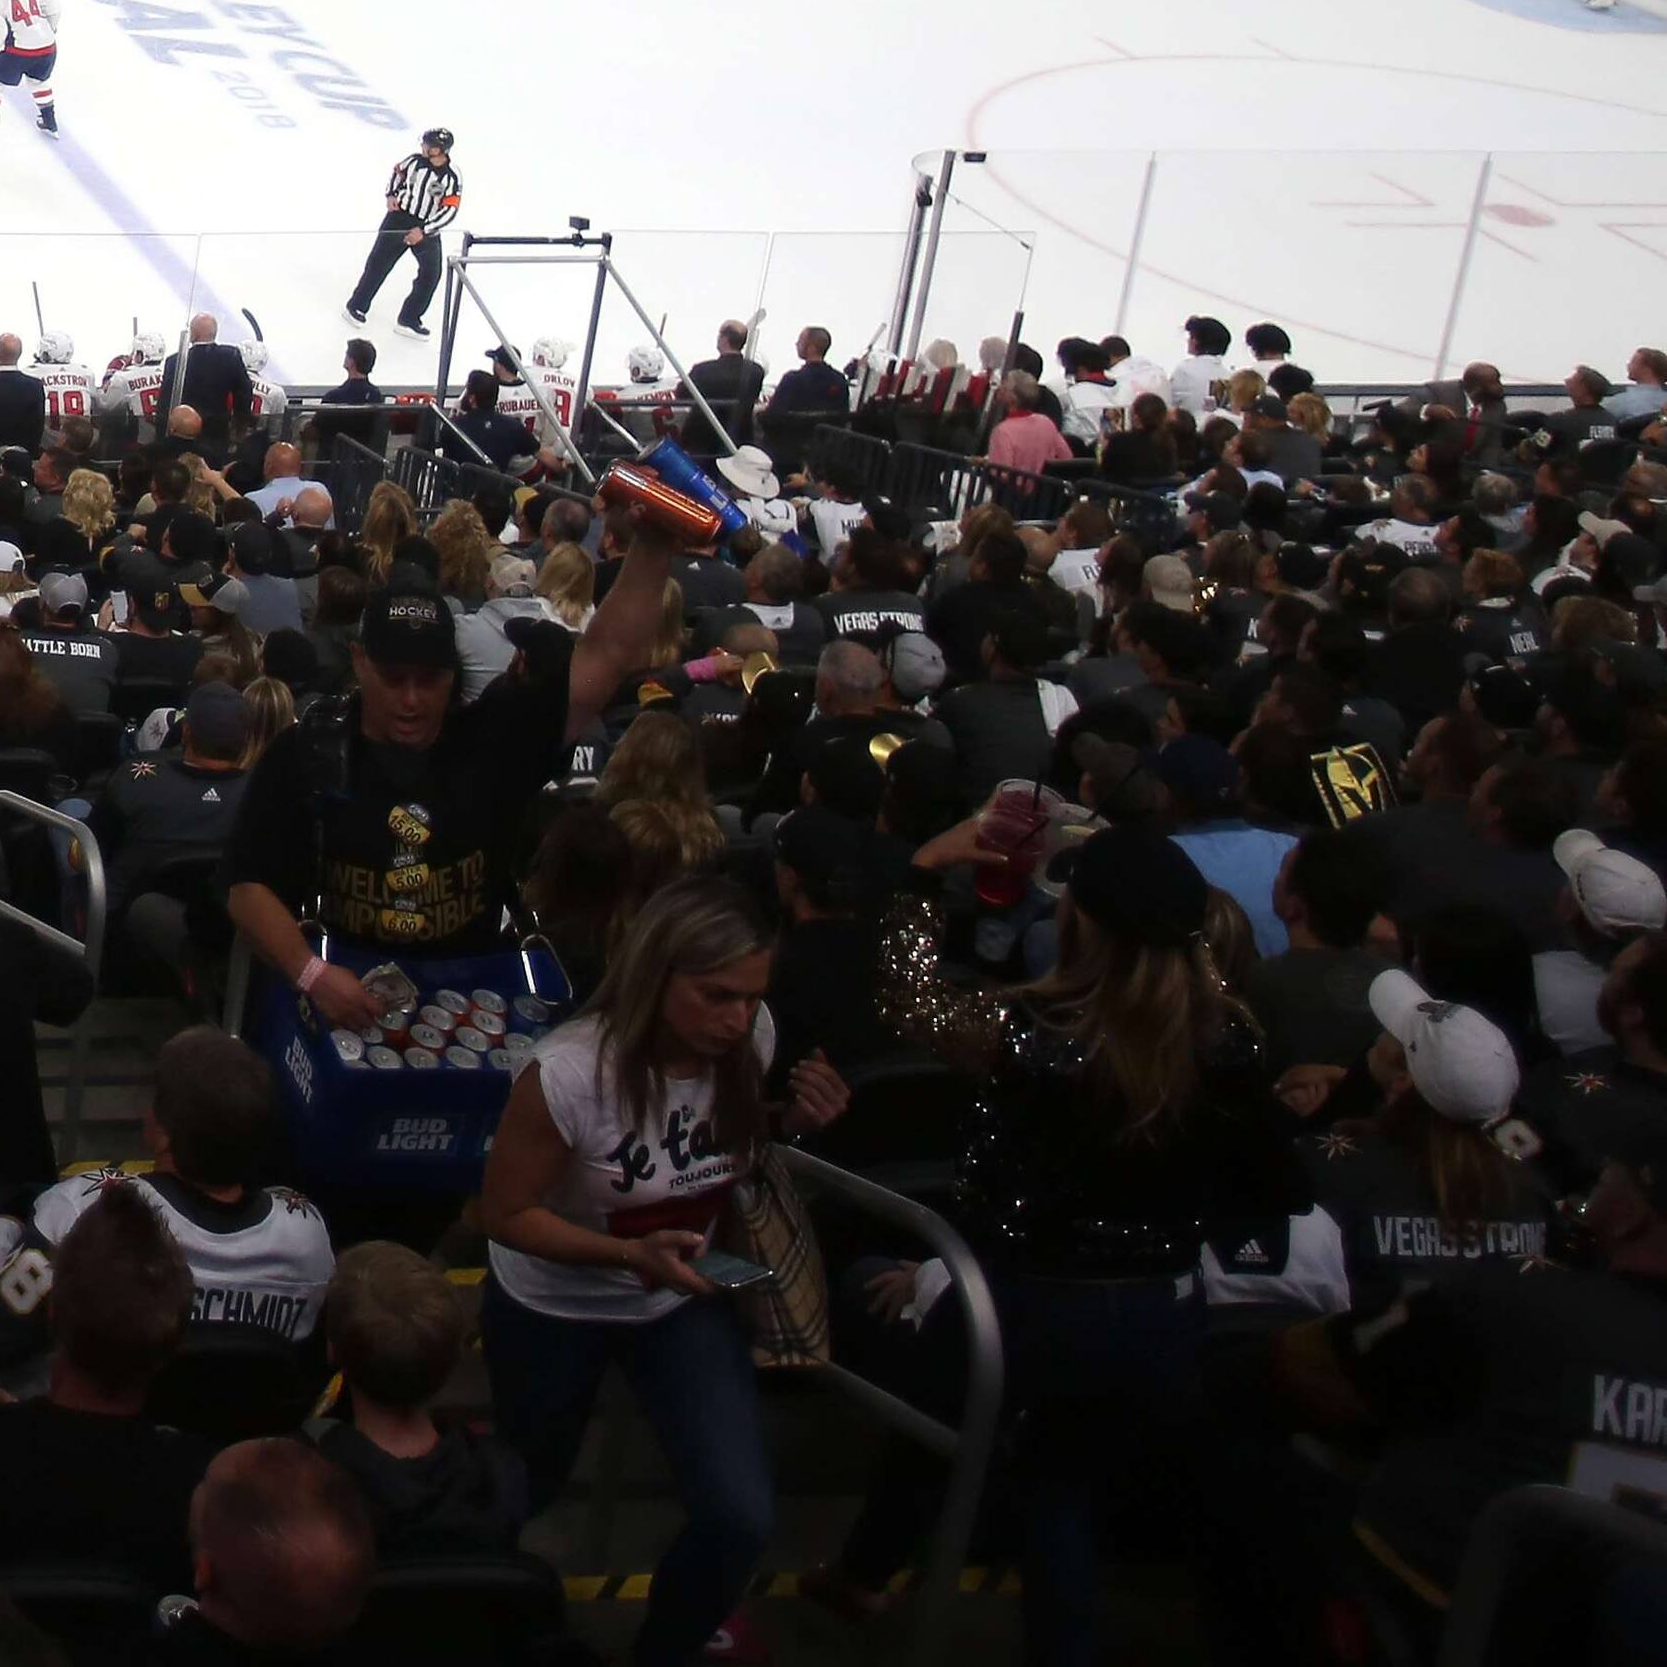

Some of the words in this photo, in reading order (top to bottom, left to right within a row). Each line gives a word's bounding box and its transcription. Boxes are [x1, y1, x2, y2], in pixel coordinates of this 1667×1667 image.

[270, 50, 412, 133] CUP
[43, 373, 88, 387] ACKSTROM
[388, 605, 437, 620] HOCKEY
[833, 612, 878, 635] VEGAS
[23, 637, 65, 655] ATTLE
[69, 639, 102, 659] BORN
[389, 813, 423, 845] 15.00
[328, 854, 451, 915] WELME
[452, 850, 485, 884] TO
[395, 872, 424, 888] 5.00
[388, 917, 417, 933] 6.00
[392, 1118, 448, 1135] BUD
[376, 1133, 454, 1151] LIGHT
[1372, 1214, 1459, 1258] VEGAS
[1461, 1216, 1549, 1258] STRON
[186, 1285, 308, 1338] SCHMIDT
